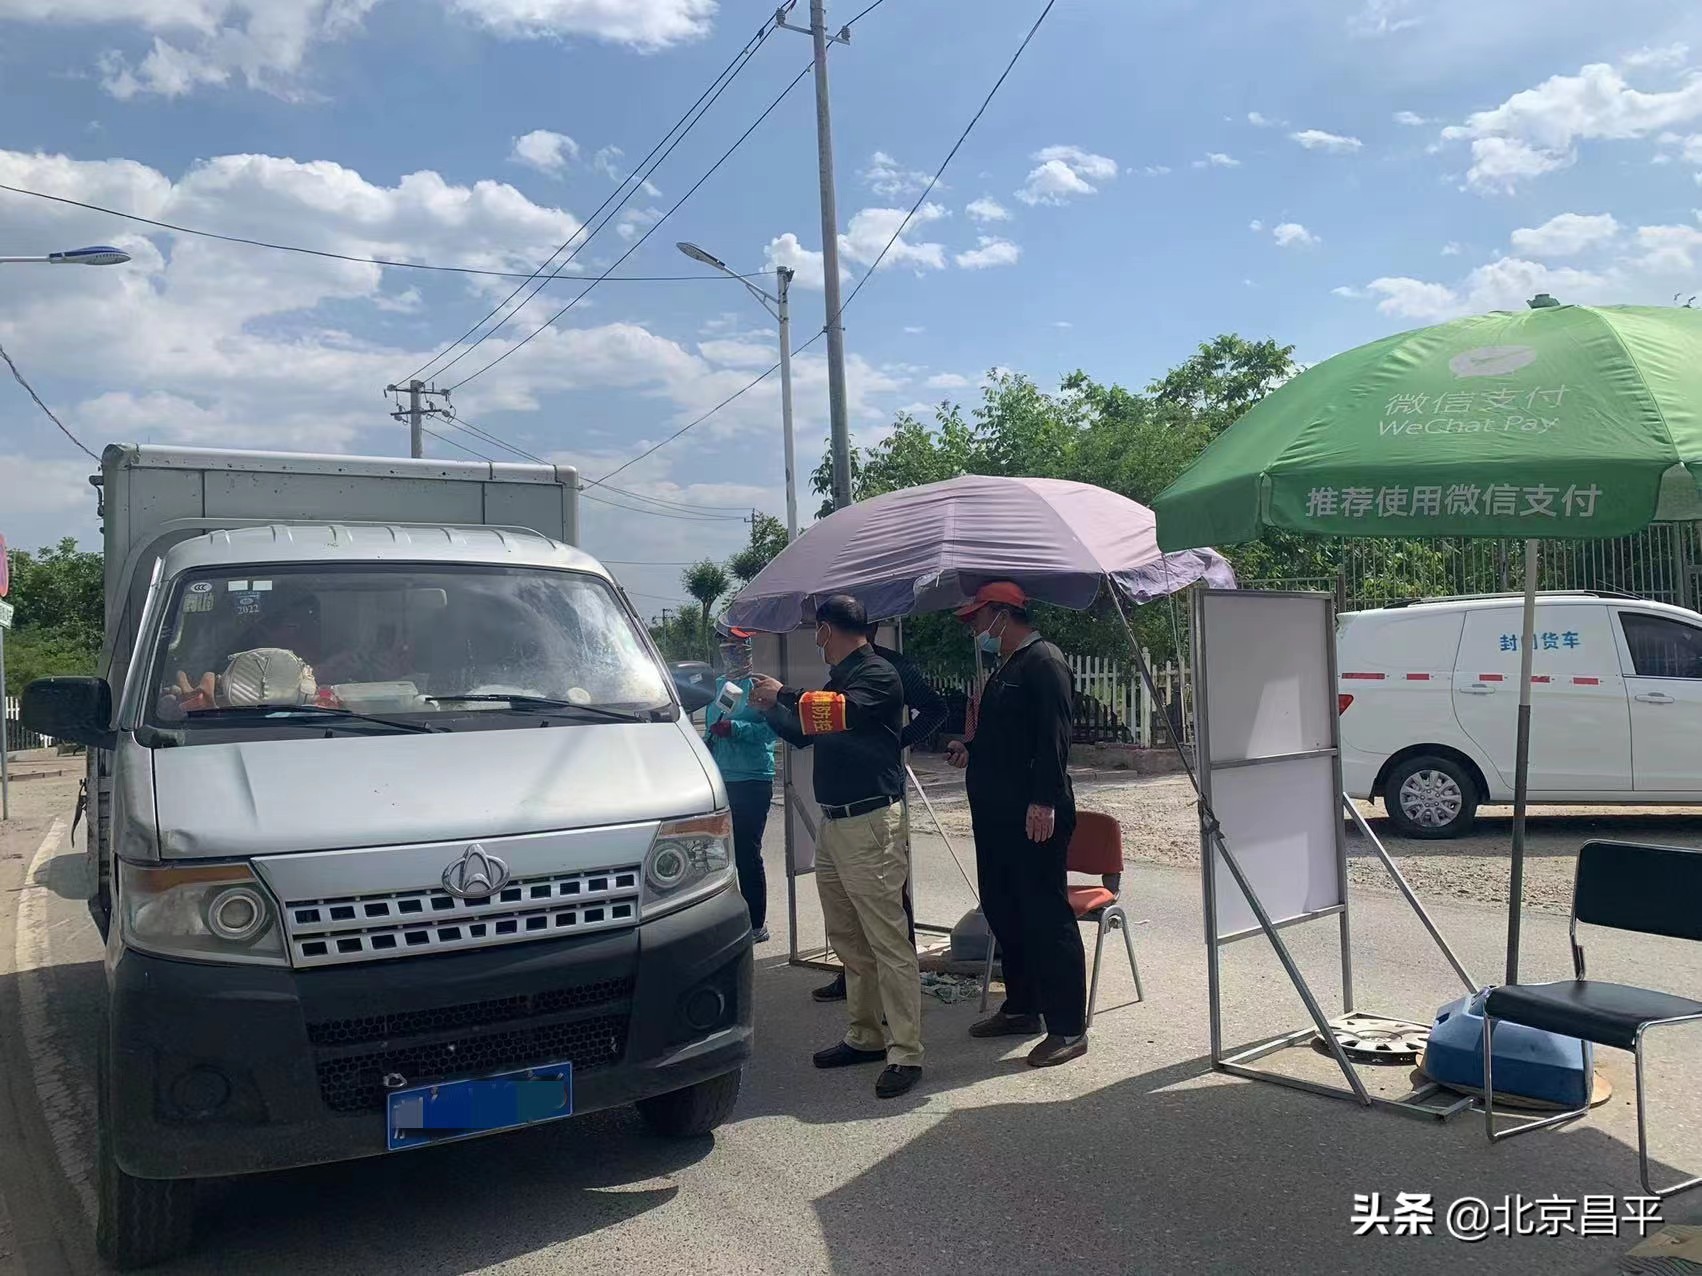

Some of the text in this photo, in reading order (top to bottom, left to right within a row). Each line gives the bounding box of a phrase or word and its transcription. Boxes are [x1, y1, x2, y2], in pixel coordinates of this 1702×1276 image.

[1384, 384, 1569, 415] 微信支付
[1379, 416, 1560, 436] WeChat Pay
[1305, 483, 1603, 518] 推荐使用微信支付
[237, 604, 260, 615] 2022
